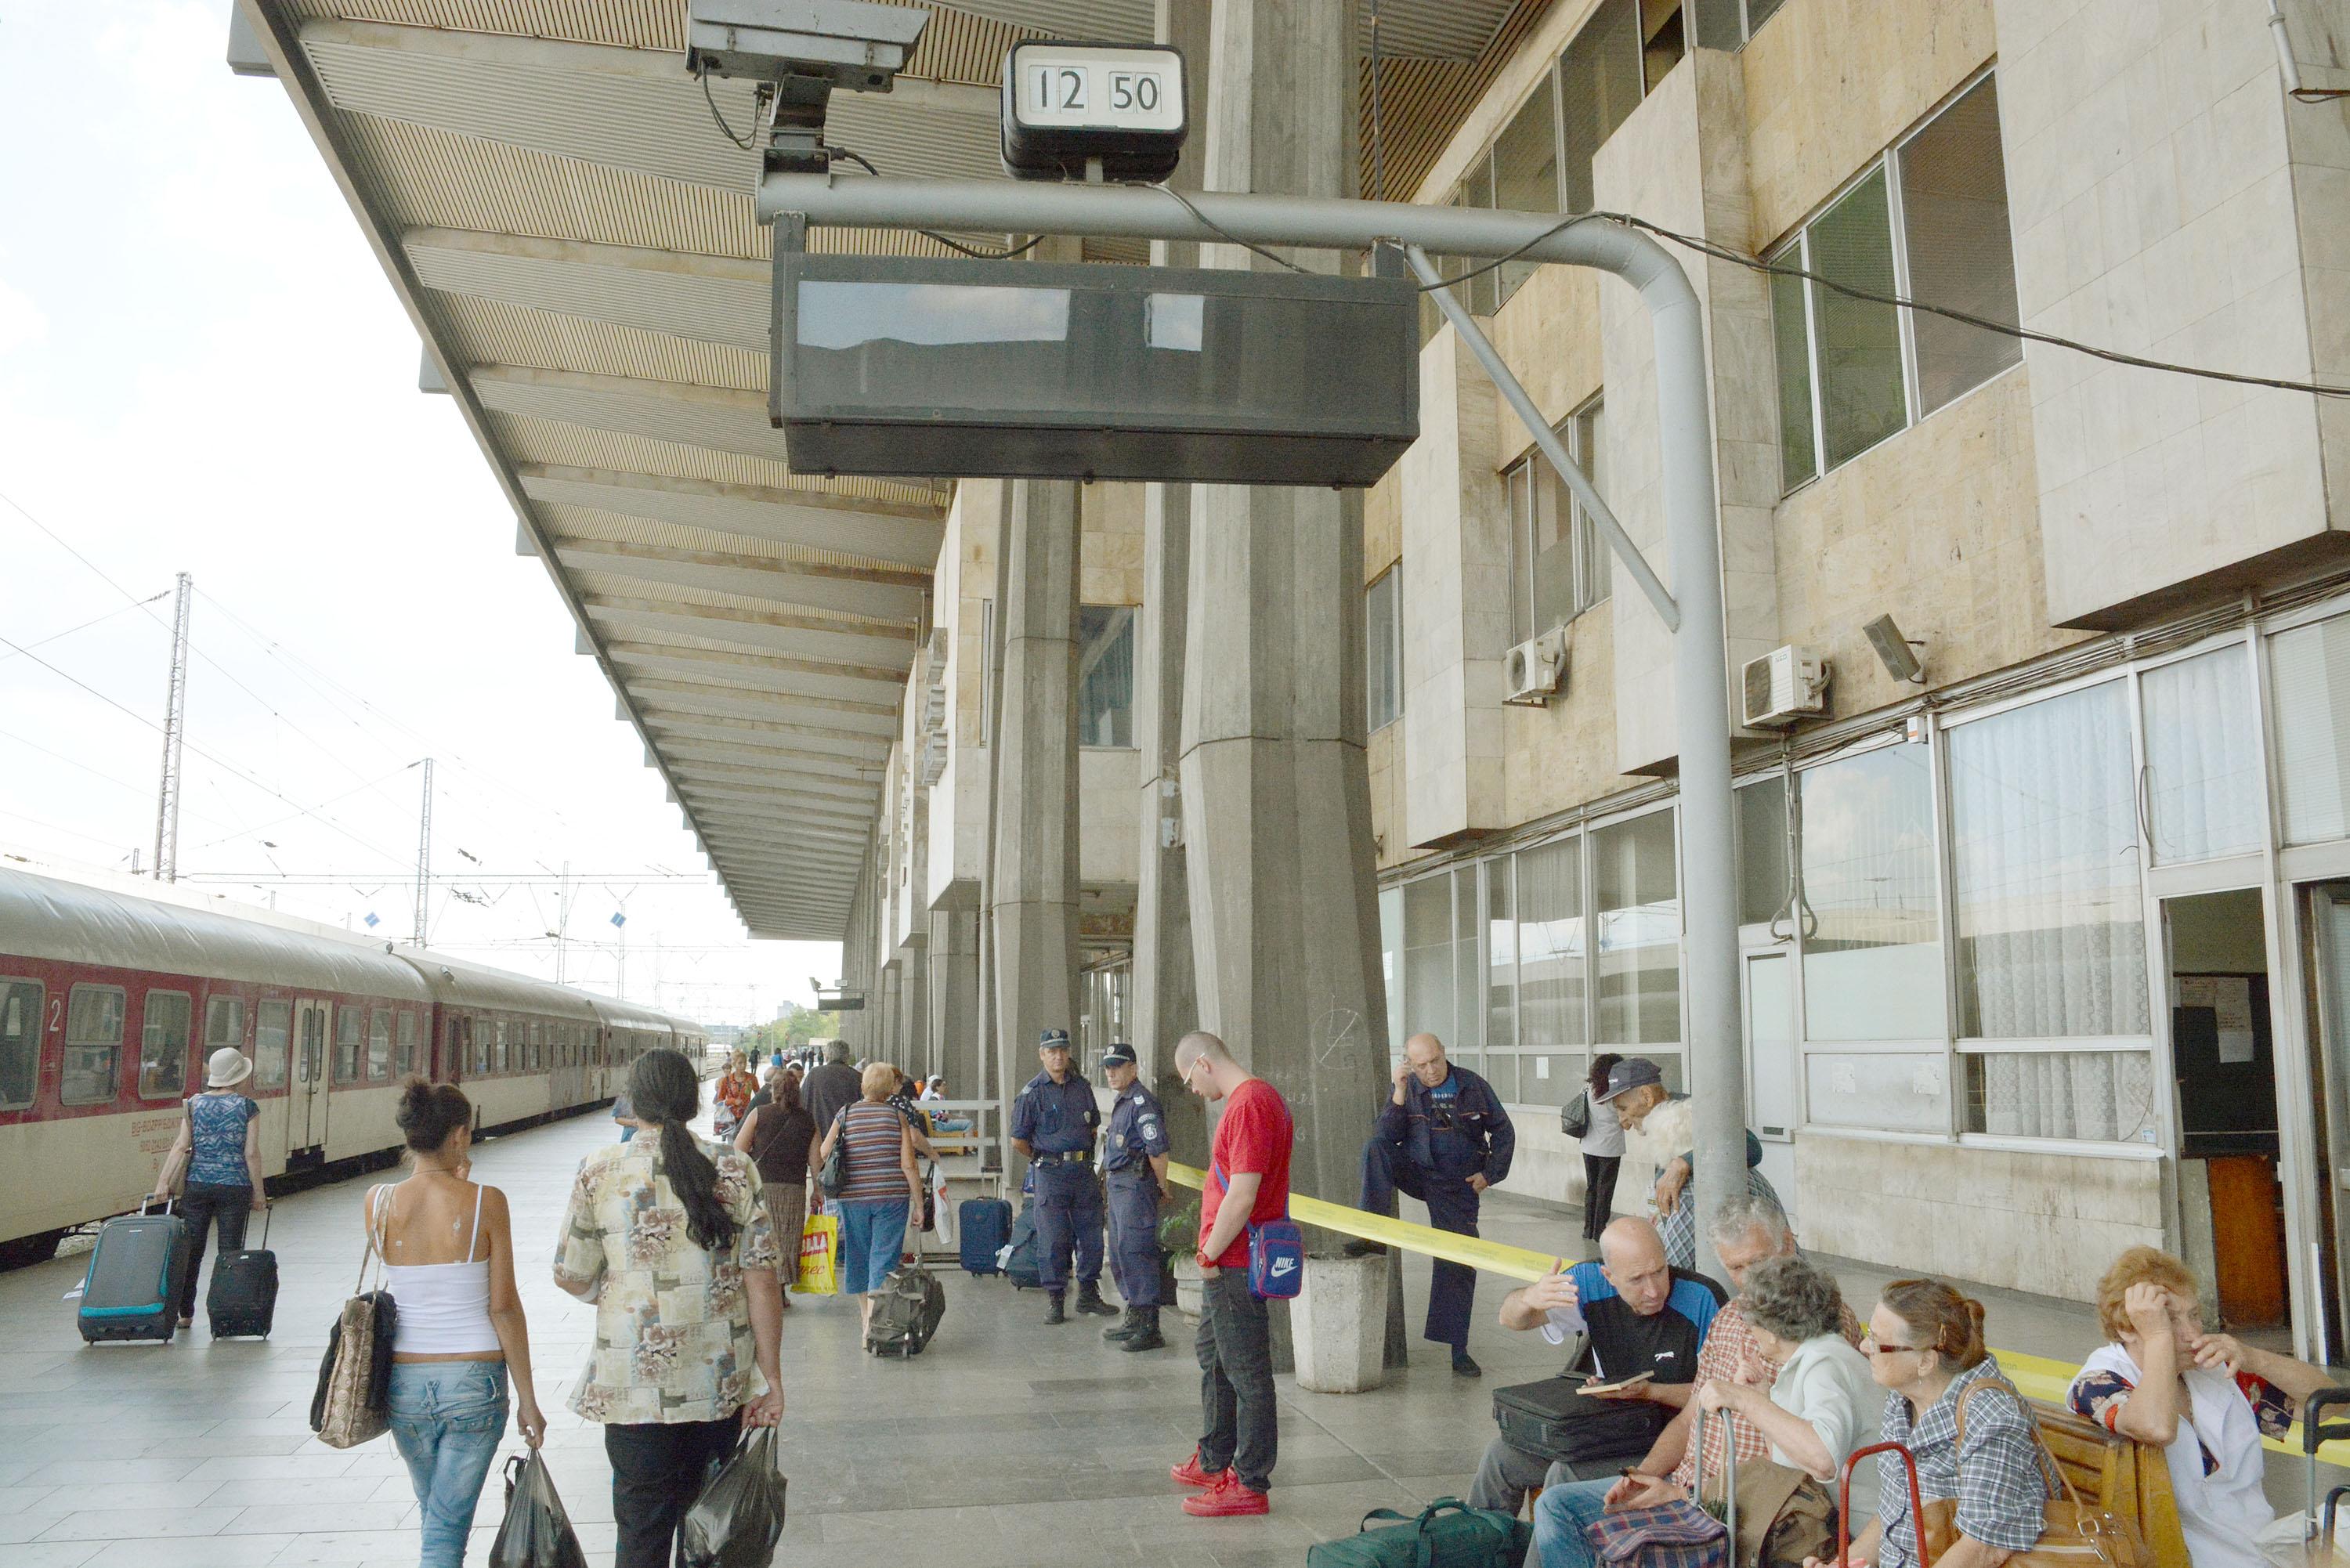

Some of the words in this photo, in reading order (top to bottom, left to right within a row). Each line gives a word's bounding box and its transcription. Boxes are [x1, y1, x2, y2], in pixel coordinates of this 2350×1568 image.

[1041, 70, 1085, 109] 12
[1113, 77, 1158, 110] 50
[49, 999, 60, 1032] 2
[247, 1013, 253, 1037] 2
[1274, 1256, 1295, 1269] NIKE
